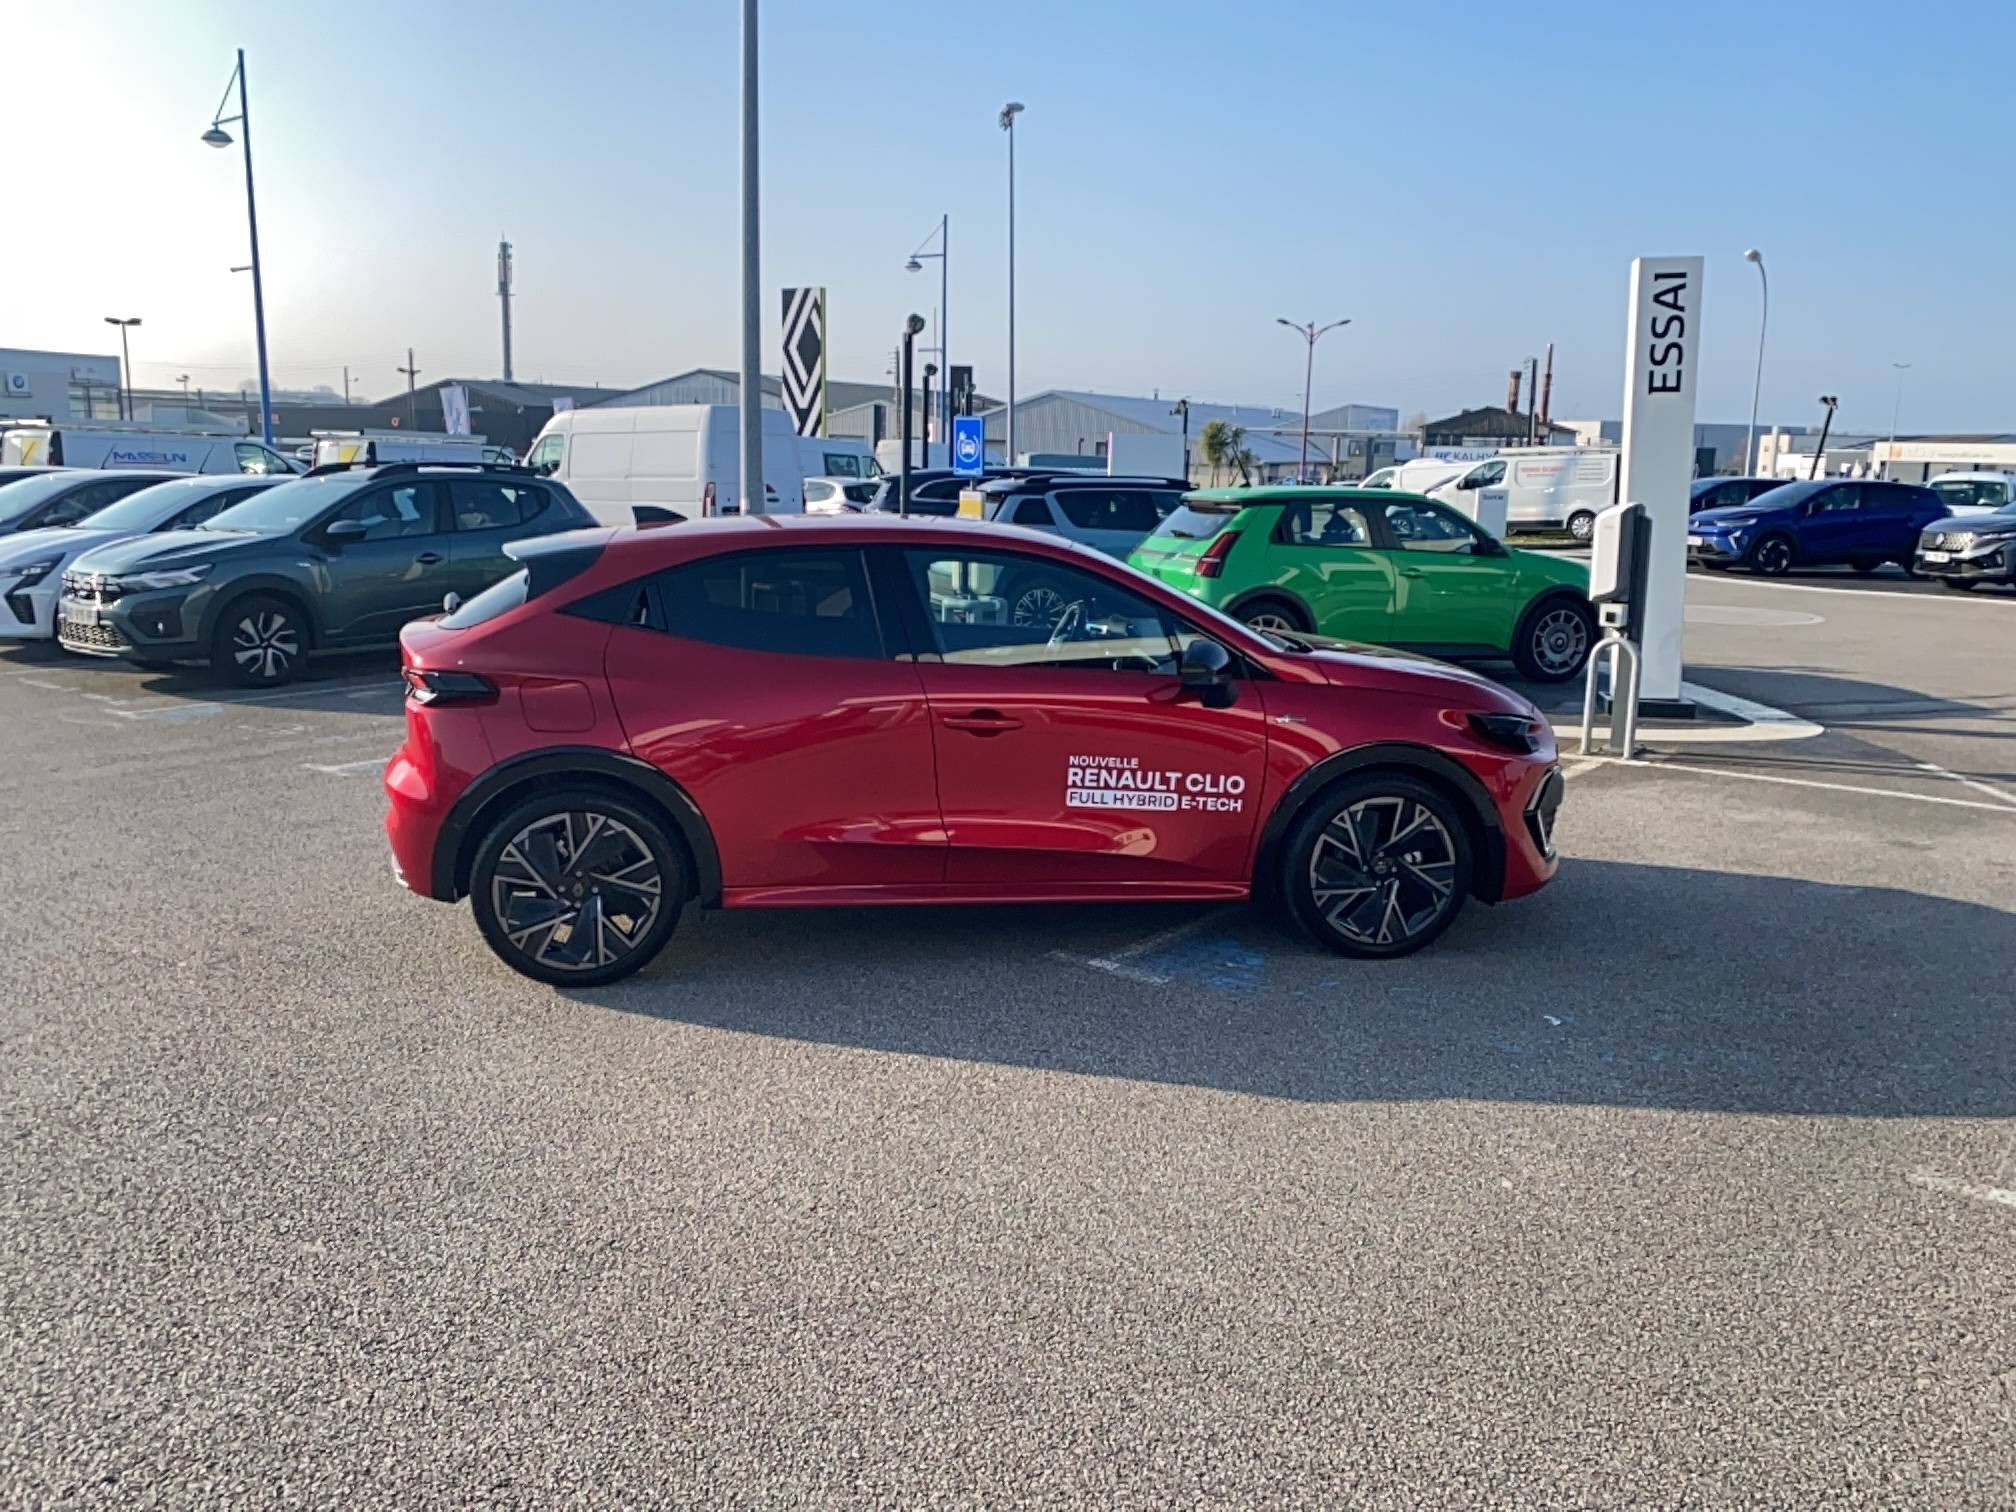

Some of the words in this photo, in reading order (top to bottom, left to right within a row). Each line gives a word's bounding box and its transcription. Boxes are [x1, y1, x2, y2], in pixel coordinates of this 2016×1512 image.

[1648, 272, 1687, 395] ESSAI
[1068, 755, 1139, 768] NOUVELLE
[1067, 767, 1182, 791] RENAULT
[1185, 773, 1246, 794] CLIO
[1069, 791, 1109, 805] FULL
[1112, 793, 1176, 808] HYBRID
[1181, 796, 1242, 812] E-TECH
